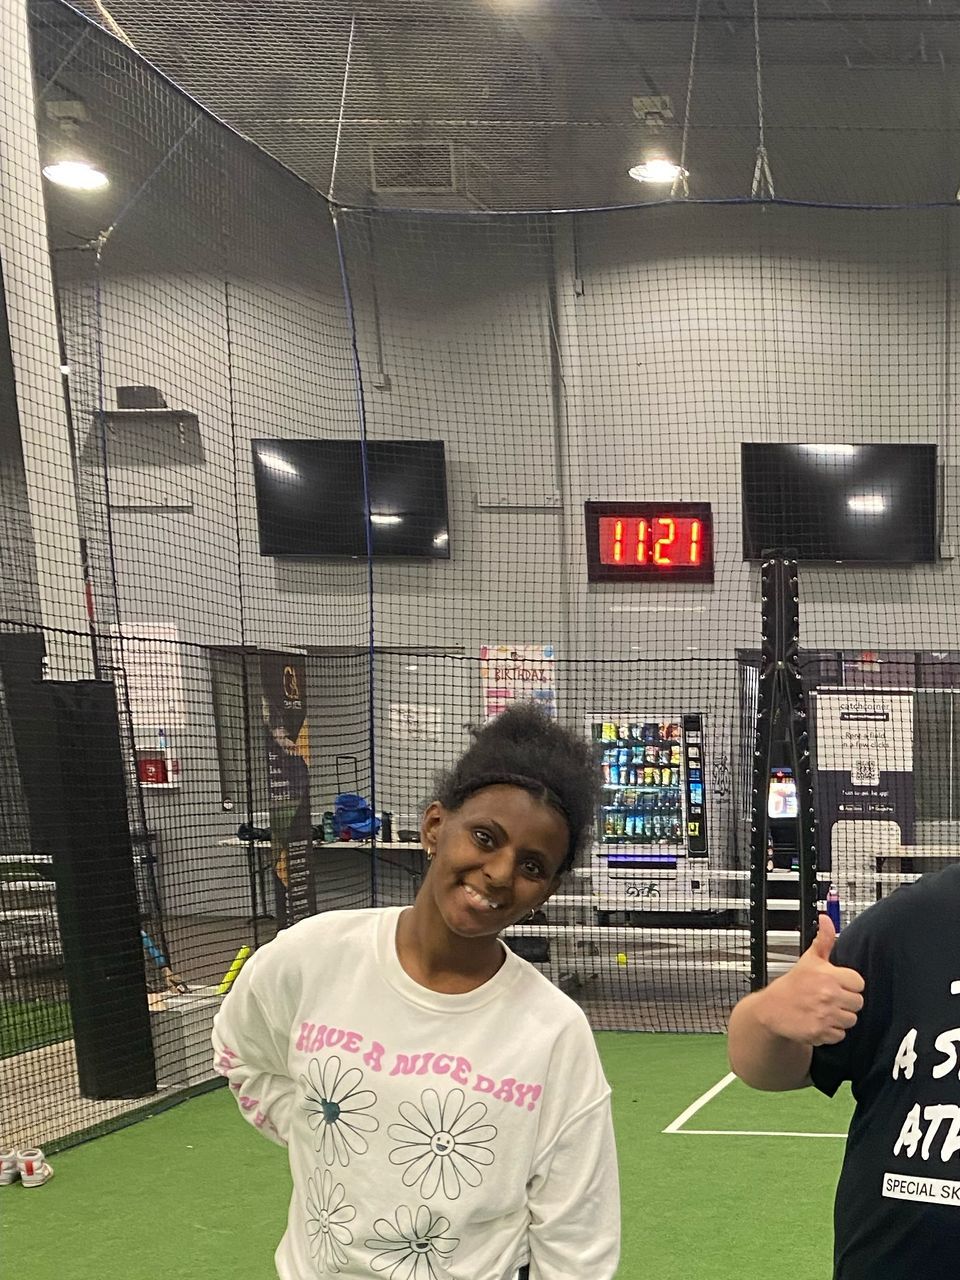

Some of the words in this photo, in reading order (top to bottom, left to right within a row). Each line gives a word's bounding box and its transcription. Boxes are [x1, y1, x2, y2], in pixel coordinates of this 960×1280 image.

[494, 668, 545, 681] BIRTHDAY
[295, 1022, 364, 1053] HAVE
[362, 1041, 385, 1072] A
[389, 1052, 472, 1085] NICE
[472, 1074, 543, 1112] DAY!
[892, 1027, 918, 1081] A
[885, 1178, 936, 1198] SPECIAL
